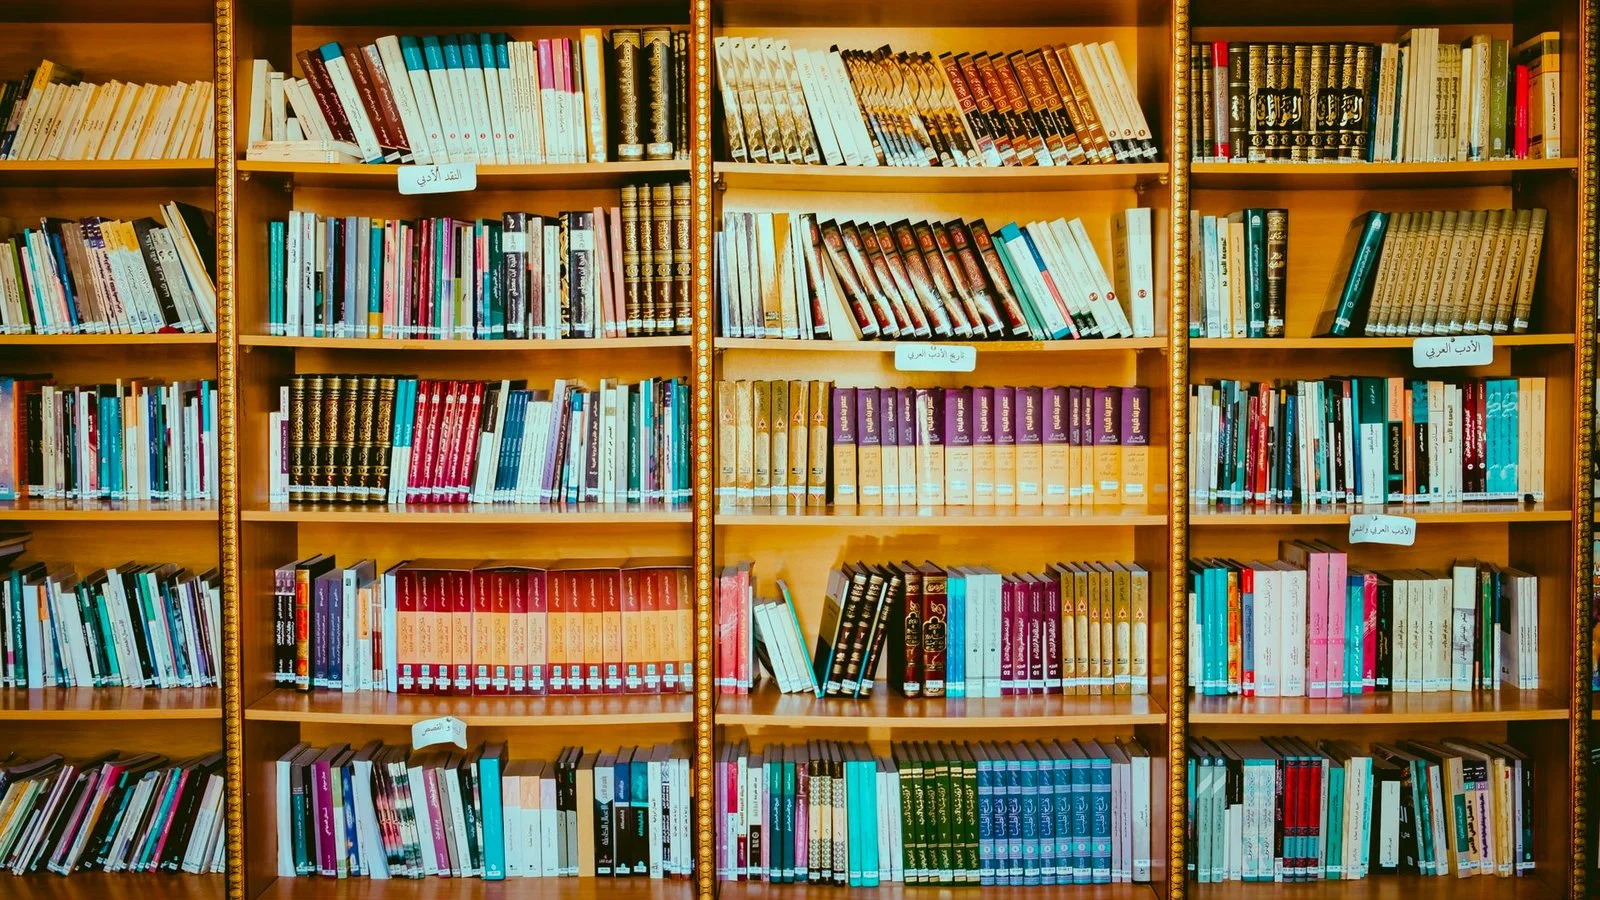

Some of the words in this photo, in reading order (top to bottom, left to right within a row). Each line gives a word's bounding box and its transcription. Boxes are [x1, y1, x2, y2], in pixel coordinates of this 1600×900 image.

[444, 168, 462, 181] النقد
[1426, 343, 1451, 360] العربي
[1454, 340, 1481, 356] الأدب
[1392, 526, 1412, 535] الأدب
